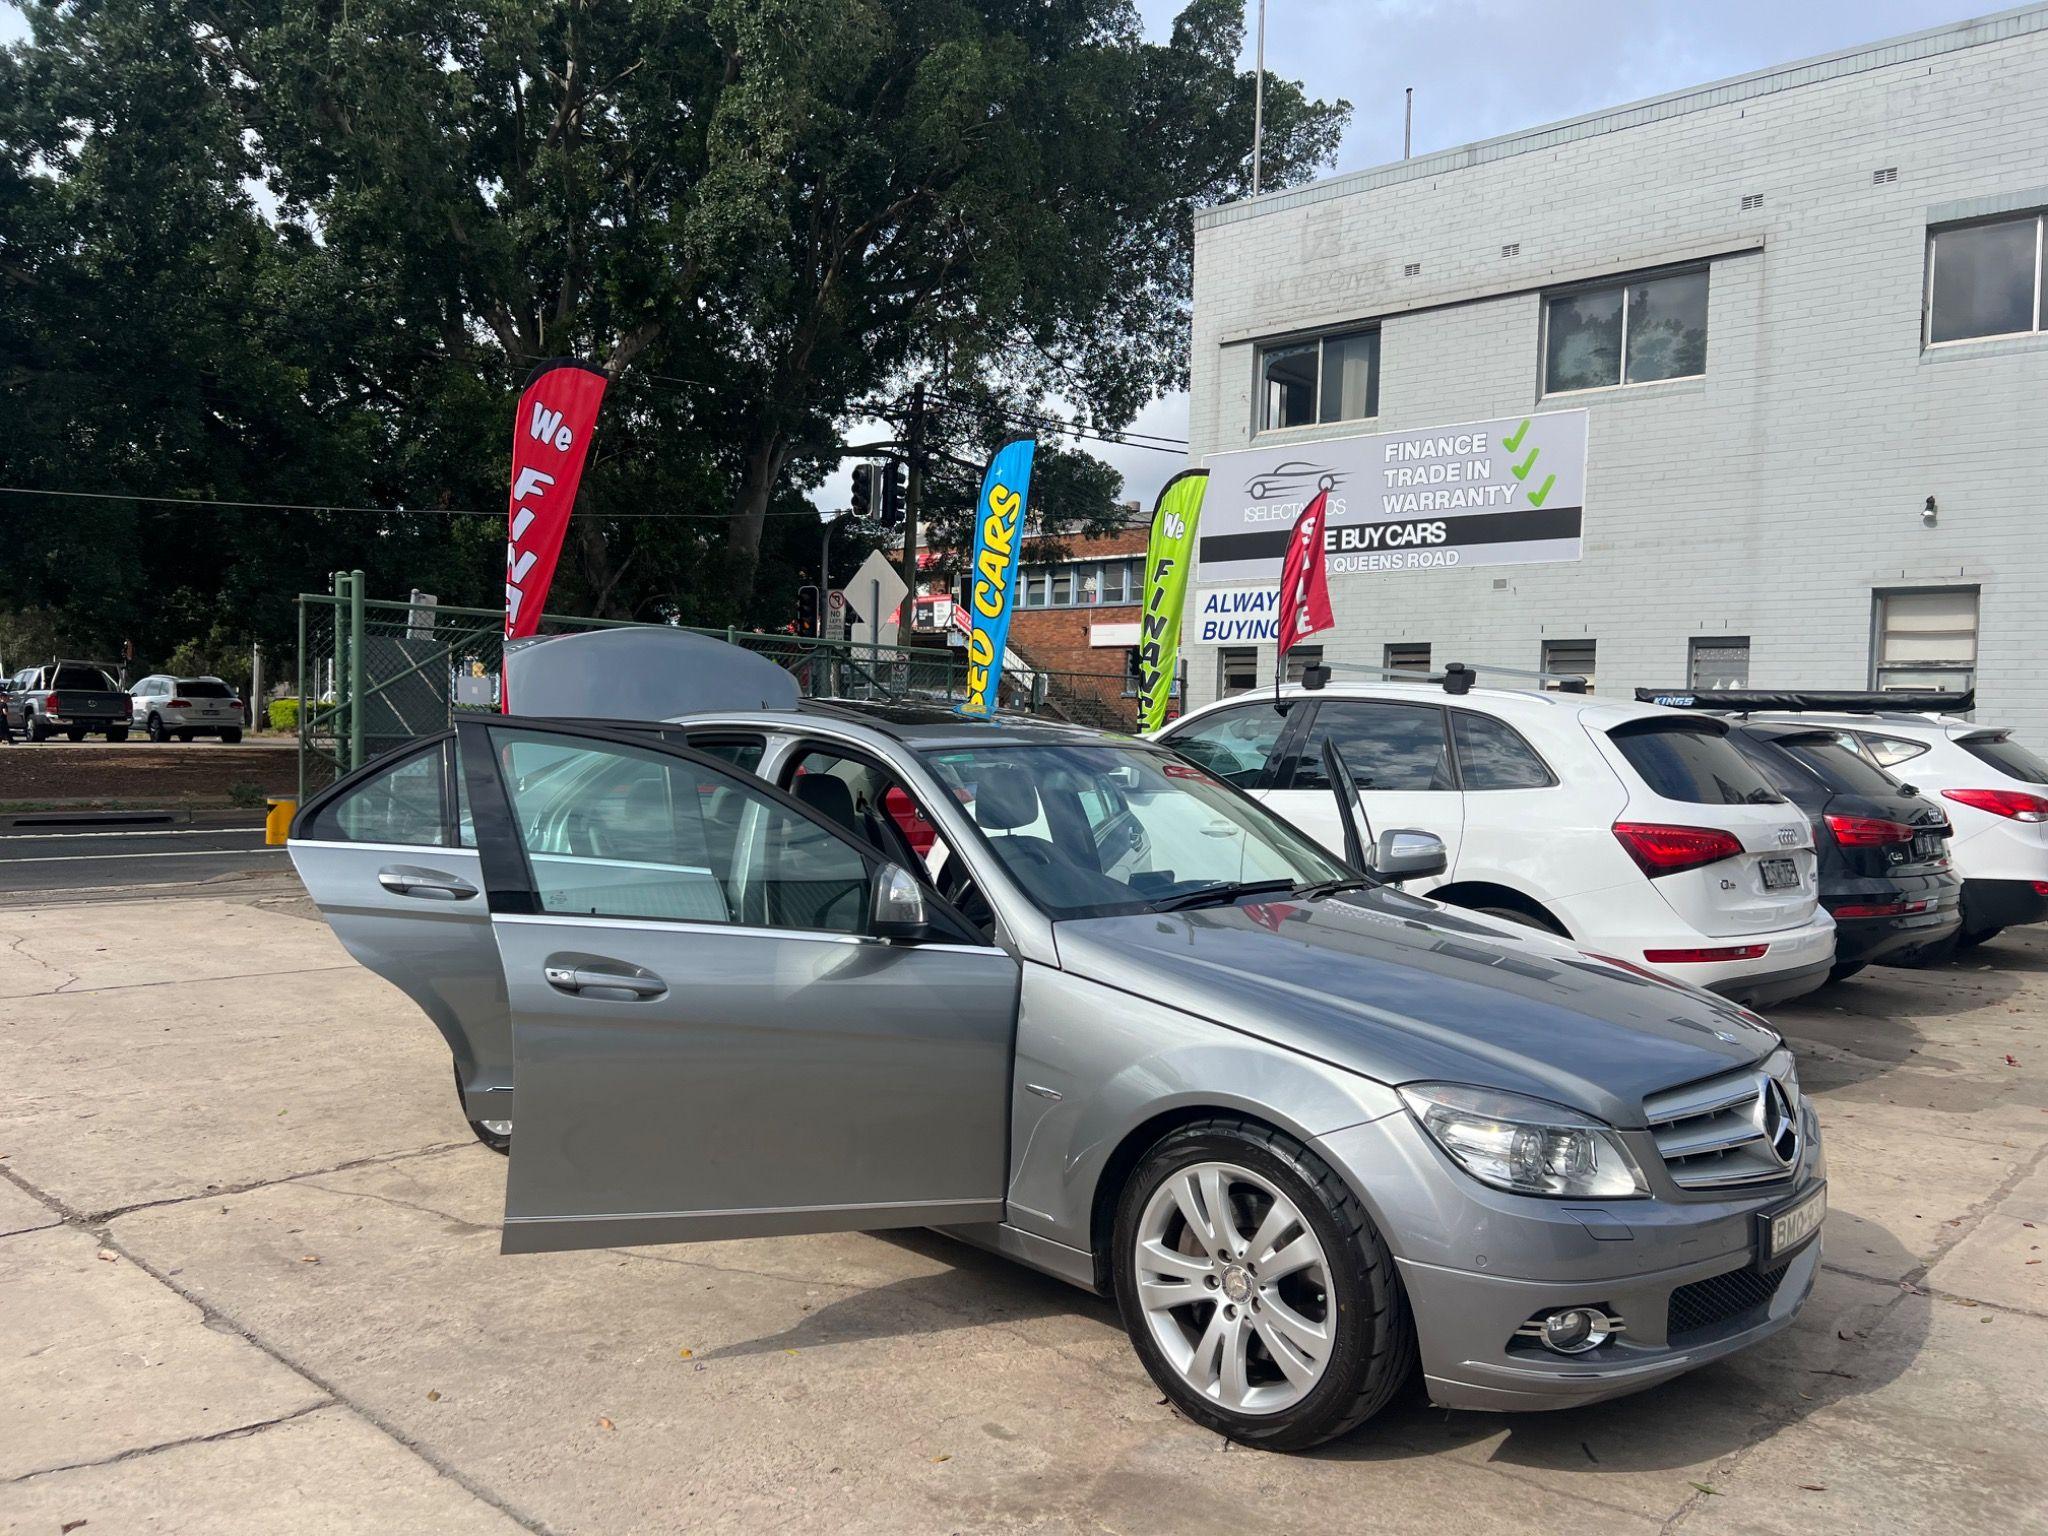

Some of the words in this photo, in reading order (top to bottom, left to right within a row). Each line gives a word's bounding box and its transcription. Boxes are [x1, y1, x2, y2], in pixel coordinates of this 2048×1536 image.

[529, 400, 573, 453] We
[1384, 432, 1488, 463] FINANCE
[1383, 461, 1461, 489] TRADE
[1466, 458, 1491, 481] IN
[1382, 483, 1519, 514] WARRANTY
[1163, 510, 1186, 540] We
[1325, 530, 1337, 550] E
[1341, 525, 1386, 550] BUY
[1386, 521, 1447, 547] CARS
[973, 483, 1022, 619] CARS
[1333, 552, 1403, 574] QUEENS
[1407, 550, 1460, 568] ROAD
[1204, 590, 1281, 615] ALWAY
[1653, 696, 1695, 706] KINGS
